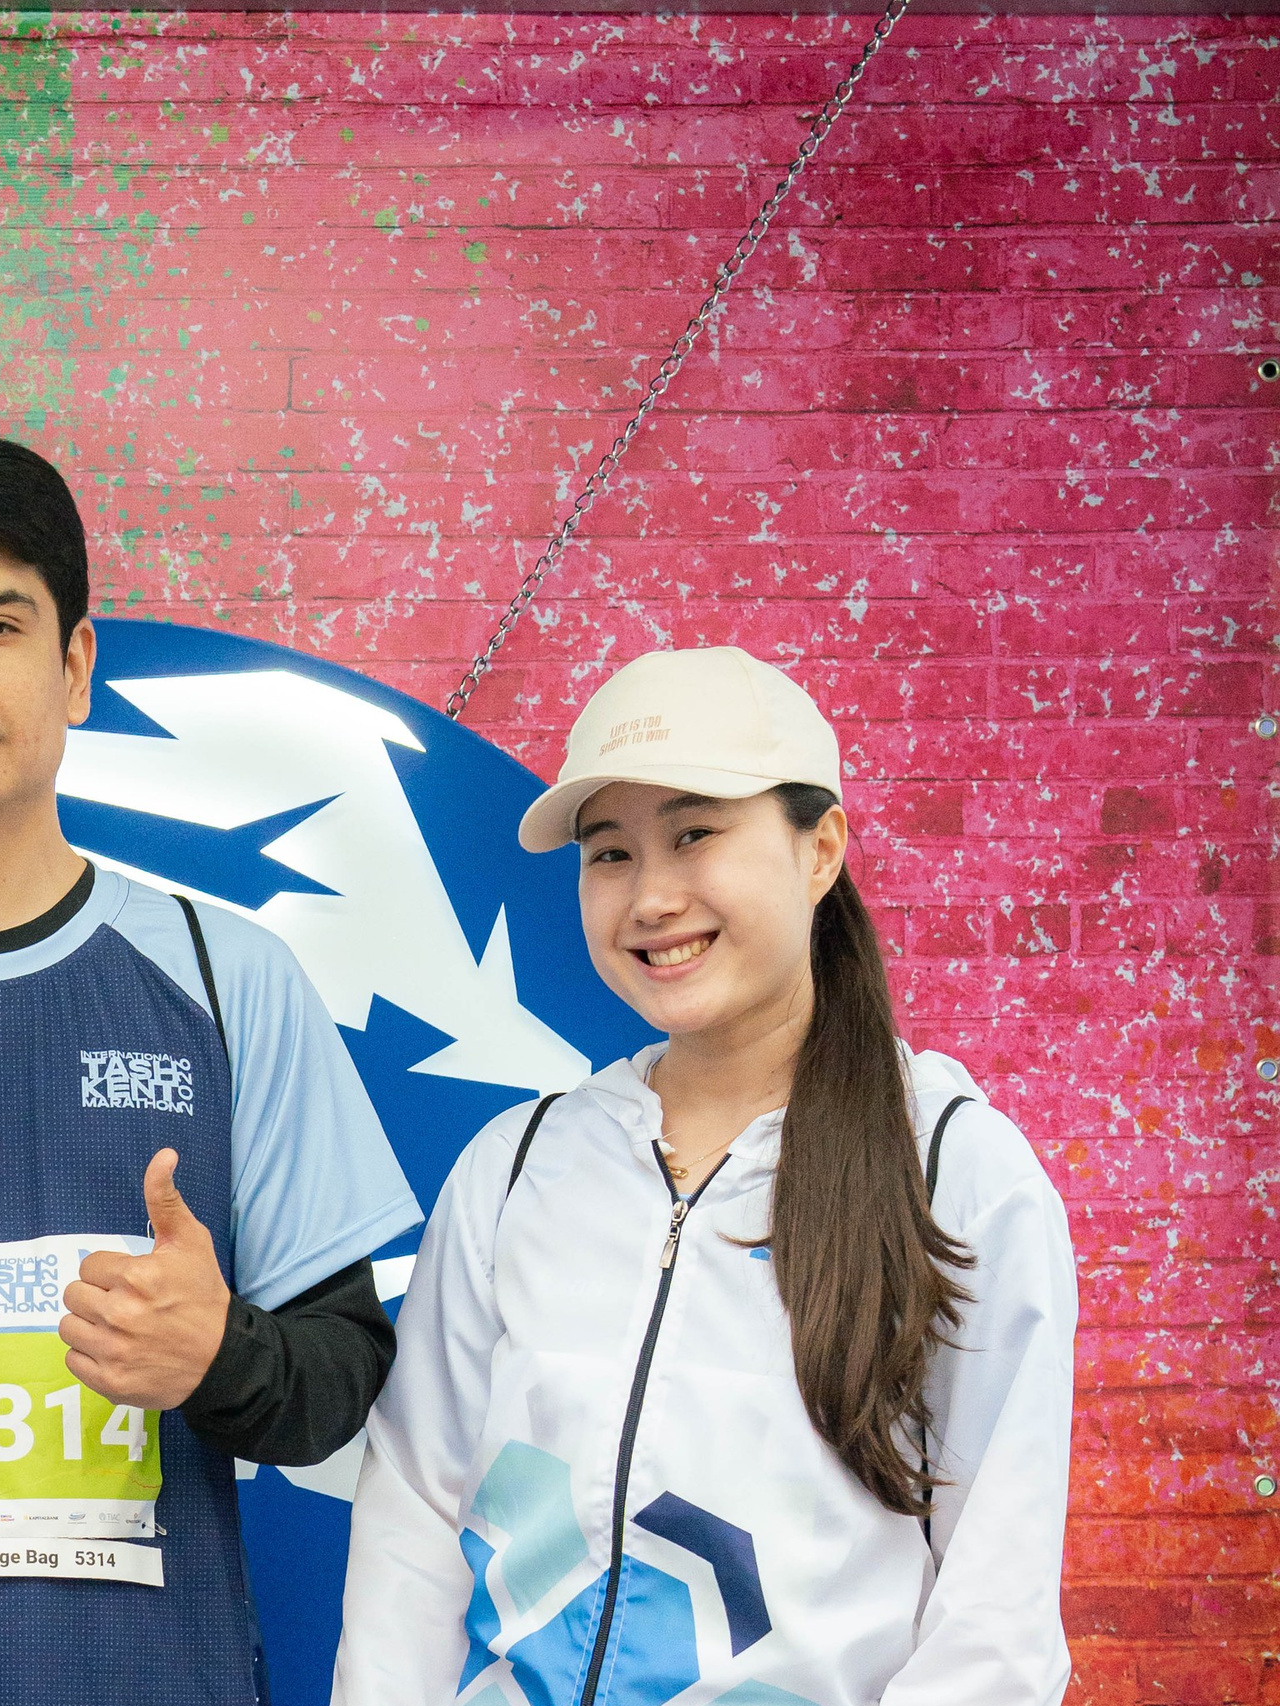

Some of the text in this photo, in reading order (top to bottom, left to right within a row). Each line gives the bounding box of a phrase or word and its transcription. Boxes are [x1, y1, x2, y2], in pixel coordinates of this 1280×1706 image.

[610, 722, 627, 739] LIFE
[629, 718, 641, 731] IS
[599, 734, 629, 757] SHORT
[632, 732, 643, 744] TO
[81, 1050, 174, 1062] INTERNATIONAL
[81, 1058, 178, 1085] TASH
[82, 1076, 173, 1103] KENT
[82, 1097, 184, 1113] MARATHON
[26, 1550, 59, 1568] Bag
[75, 1551, 116, 1567] 5314
